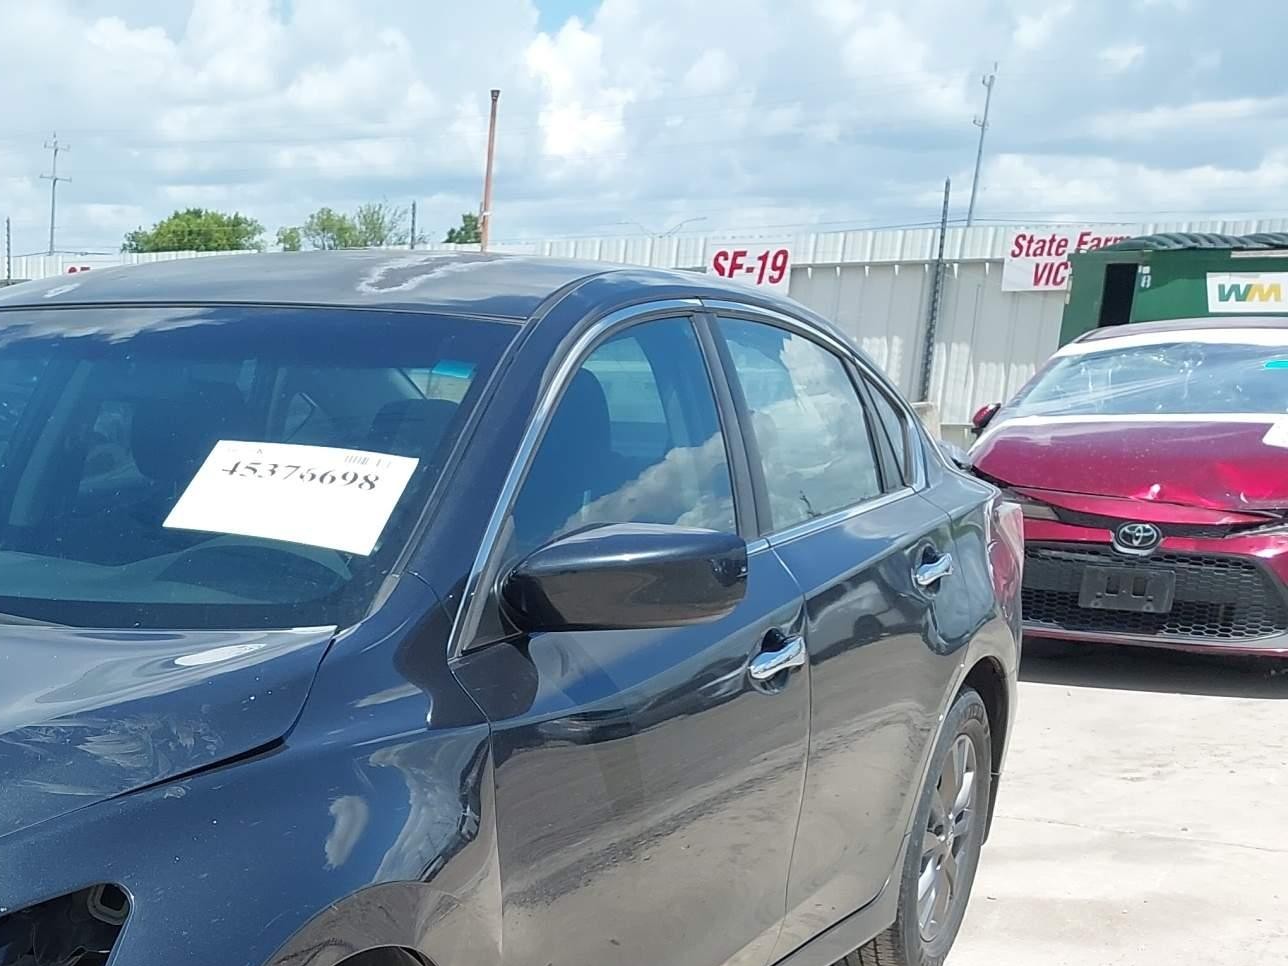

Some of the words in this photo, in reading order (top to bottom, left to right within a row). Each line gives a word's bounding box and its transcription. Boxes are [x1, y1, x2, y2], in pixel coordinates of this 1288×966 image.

[1011, 233, 1069, 258] State
[1076, 231, 1132, 251] Far
[712, 249, 790, 285] SF-19
[1218, 284, 1281, 302] WM
